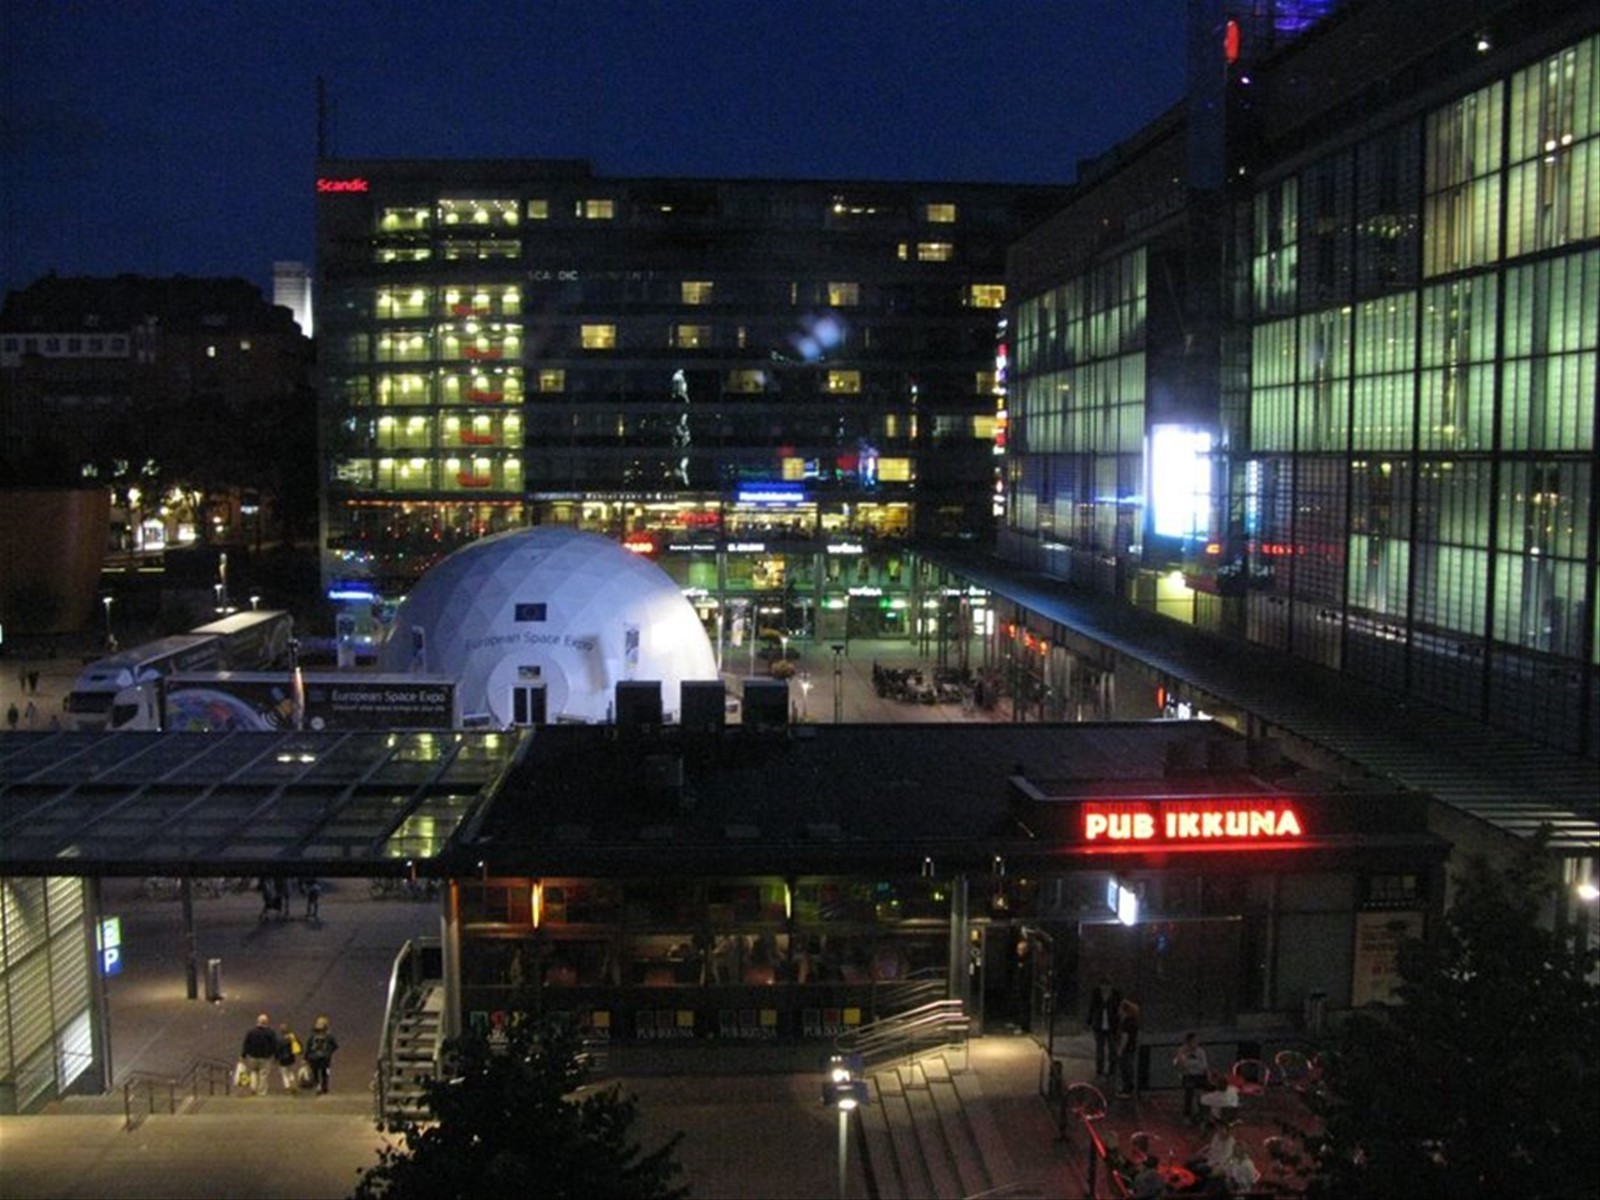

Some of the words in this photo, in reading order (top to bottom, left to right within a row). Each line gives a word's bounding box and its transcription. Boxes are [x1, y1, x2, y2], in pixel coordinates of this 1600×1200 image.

[317, 178, 368, 192] Scandic
[524, 631, 560, 646] Space
[564, 635, 594, 652] Expo
[331, 689, 382, 703] European
[384, 690, 417, 703] Space
[419, 690, 446, 704] Expo
[1085, 812, 1154, 840] PUB
[1165, 809, 1301, 838] IKKUNA
